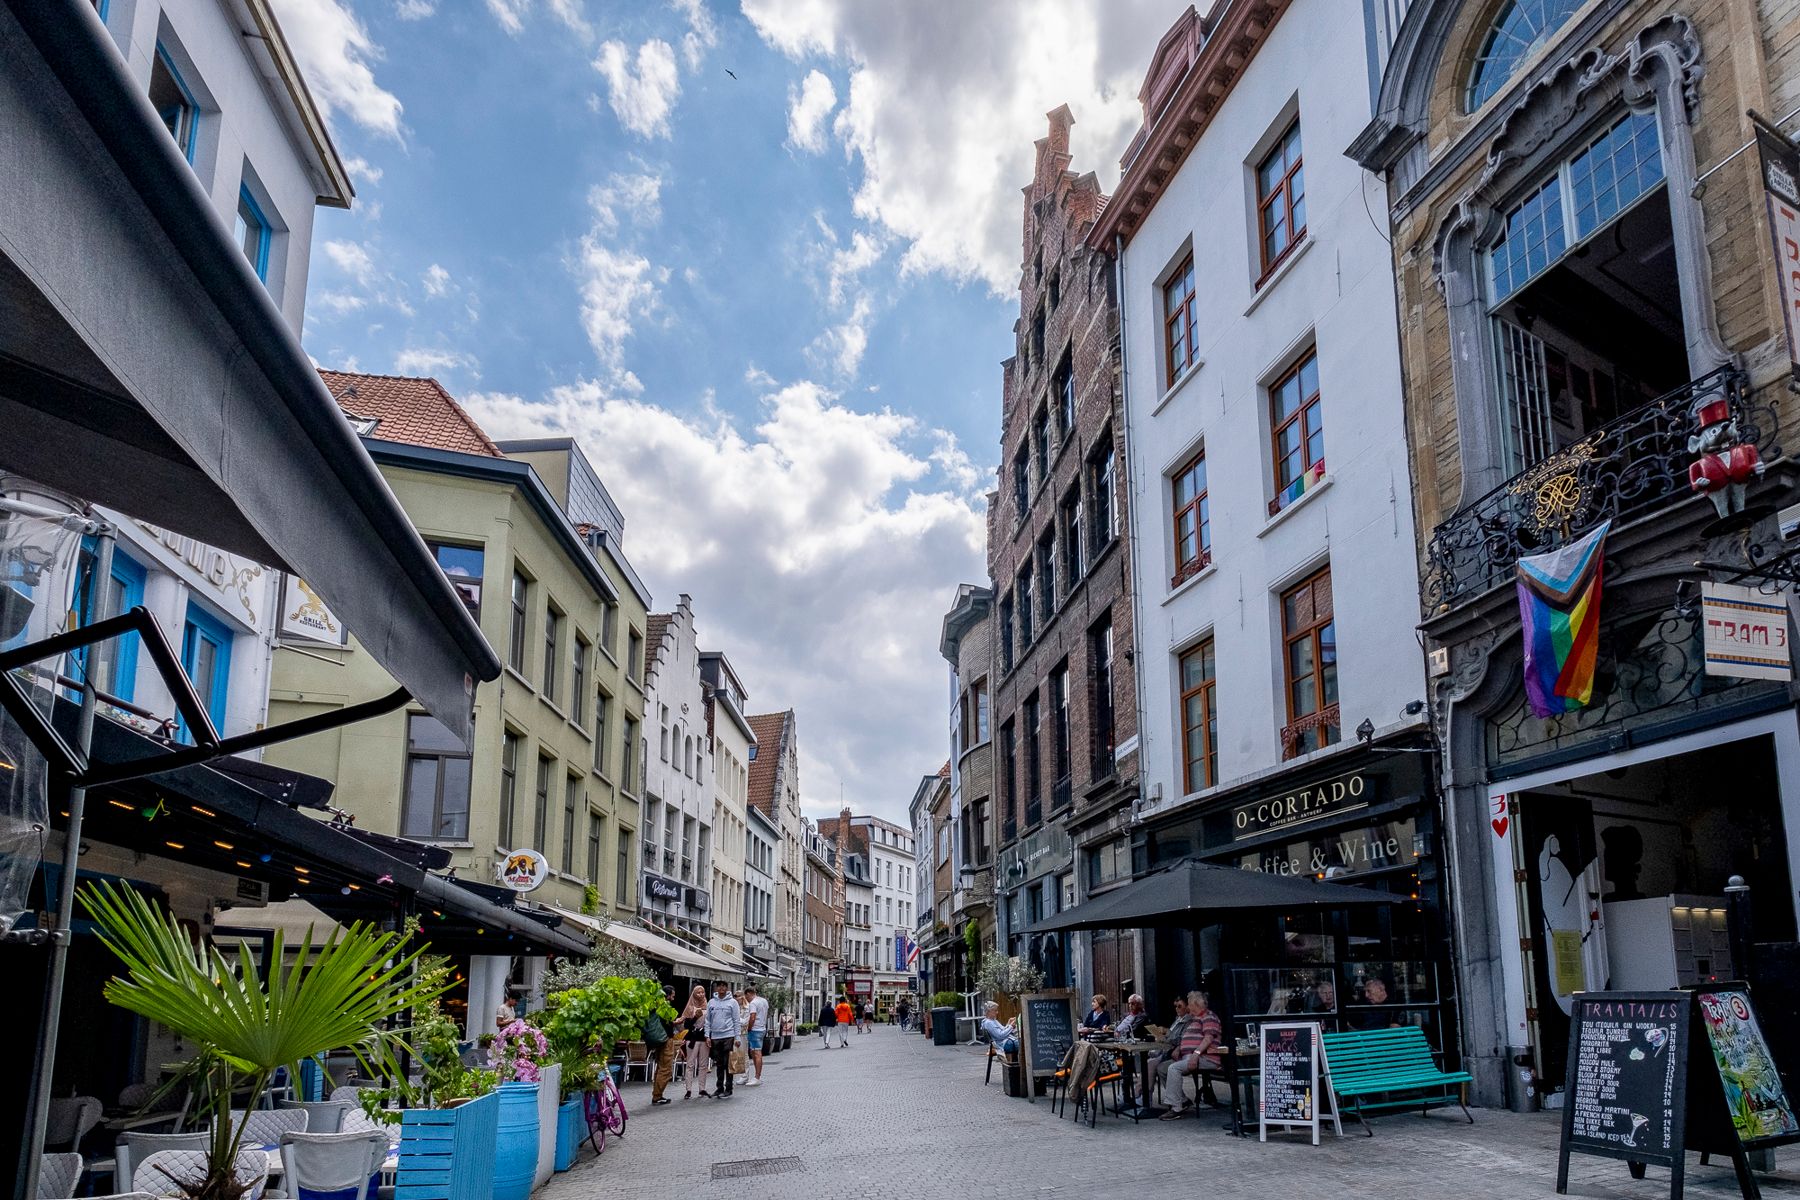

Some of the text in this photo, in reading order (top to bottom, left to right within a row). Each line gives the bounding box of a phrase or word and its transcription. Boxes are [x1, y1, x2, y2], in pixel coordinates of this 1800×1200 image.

[303, 616, 323, 627] GRILL
[1708, 620, 1786, 647] TRAM 3
[1236, 776, 1364, 829] O-CORTADO
[1490, 794, 1506, 815] 3
[1300, 808, 1323, 818] ANTWERP
[1310, 848, 1328, 871] &
[1337, 836, 1399, 865] Wine
[1733, 1000, 1744, 1015] 3
[1580, 1033, 1607, 1041] PORNSTAR
[1579, 1052, 1598, 1060] MOJITO
[1577, 1084, 1600, 1092] WHISKEY
[1576, 1090, 1597, 1098] SKINNY
[1575, 1097, 1599, 1105] NEGRONI
[1575, 1103, 1602, 1112] ESPRESSO
[1605, 1106, 1630, 1115] MARTINI
[1586, 1124, 1600, 1132] LADY
[1587, 1130, 1606, 1139] ISLAND
[1607, 1133, 1620, 1141] ICED
